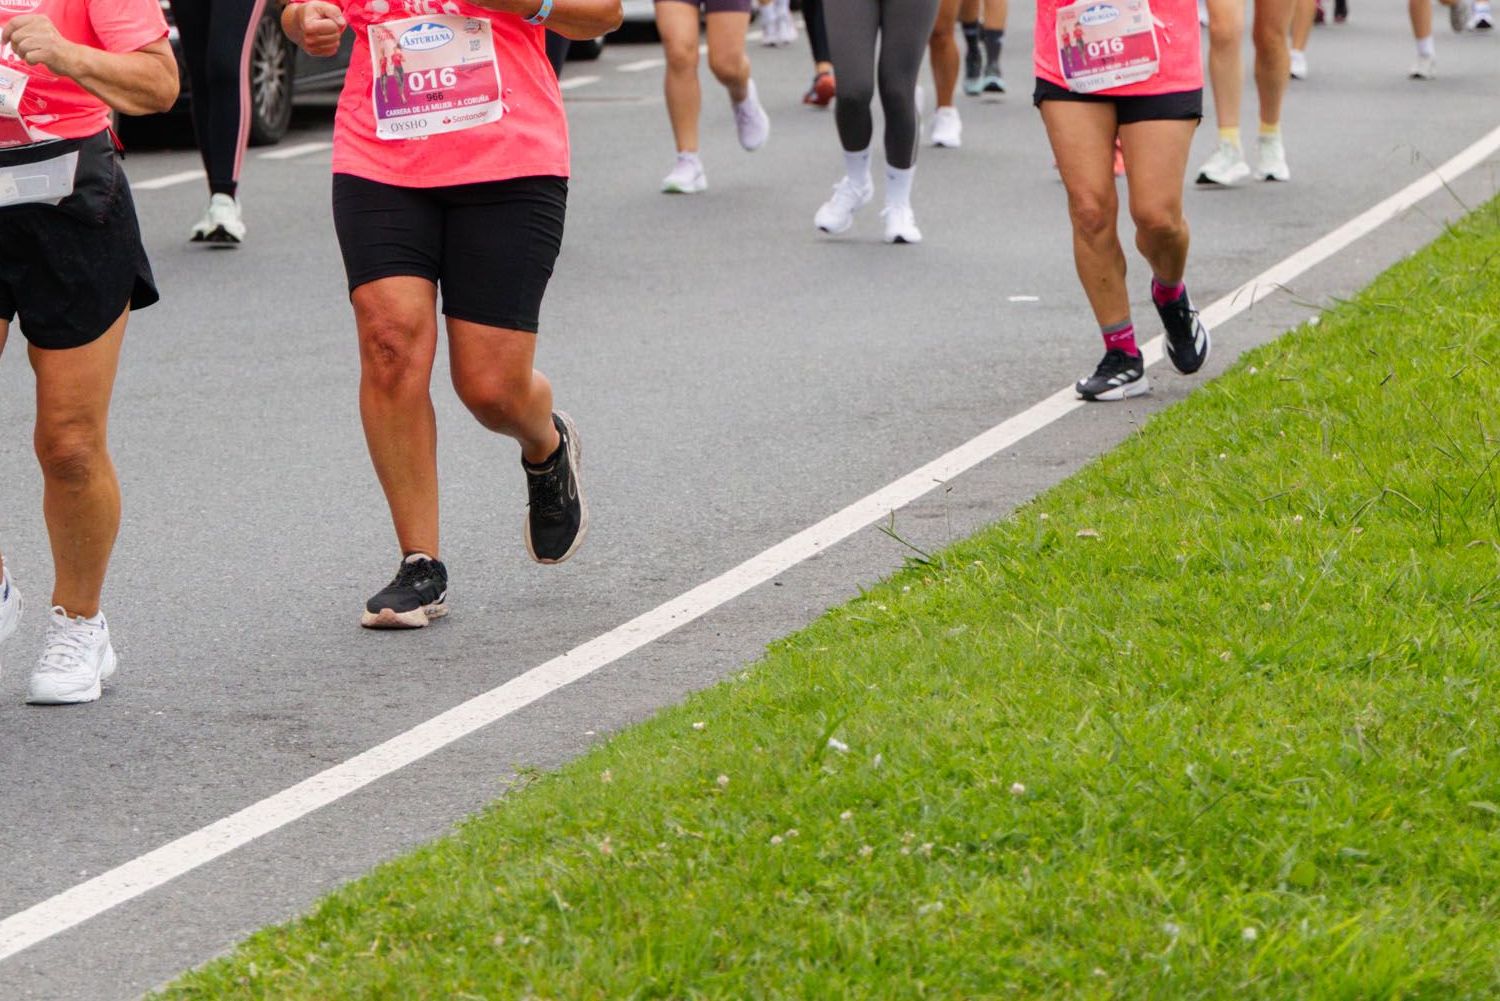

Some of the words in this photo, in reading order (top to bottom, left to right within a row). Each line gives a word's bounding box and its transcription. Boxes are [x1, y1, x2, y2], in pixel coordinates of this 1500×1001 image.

[403, 33, 450, 46] ASTURIANA
[1087, 37, 1124, 57] 016
[408, 67, 457, 91] 016
[426, 92, 444, 102] 966
[386, 107, 411, 117] CARRERA
[431, 101, 452, 111] MUJER
[463, 95, 489, 105] CORUÑA
[390, 118, 428, 133] OYSHO
